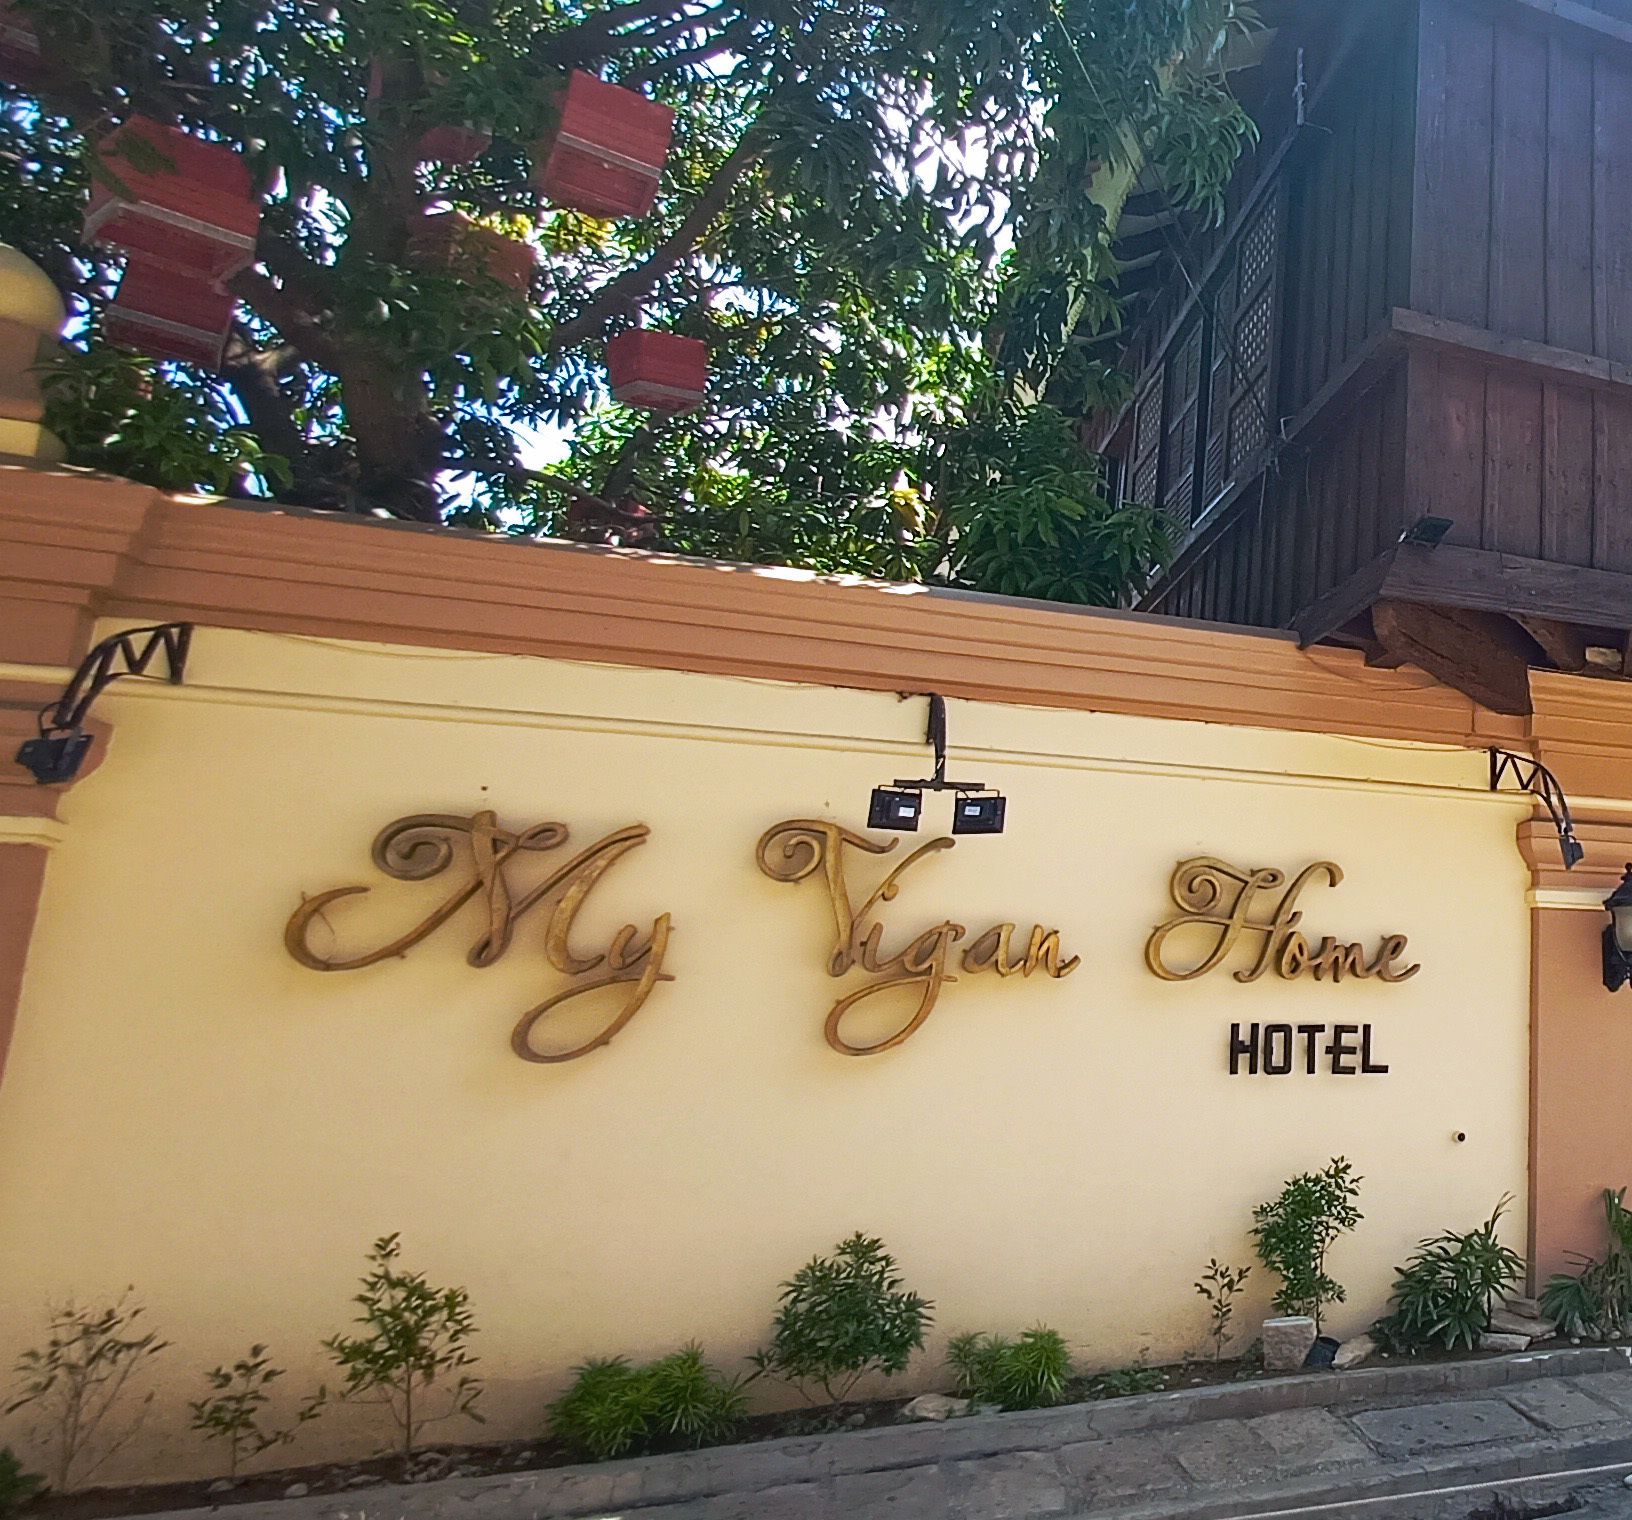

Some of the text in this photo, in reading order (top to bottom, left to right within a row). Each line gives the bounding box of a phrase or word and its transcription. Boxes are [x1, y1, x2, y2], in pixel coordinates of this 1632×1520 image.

[286, 810, 1421, 1064] My Vigan Home
[1229, 1022, 1389, 1076] HOTEL
